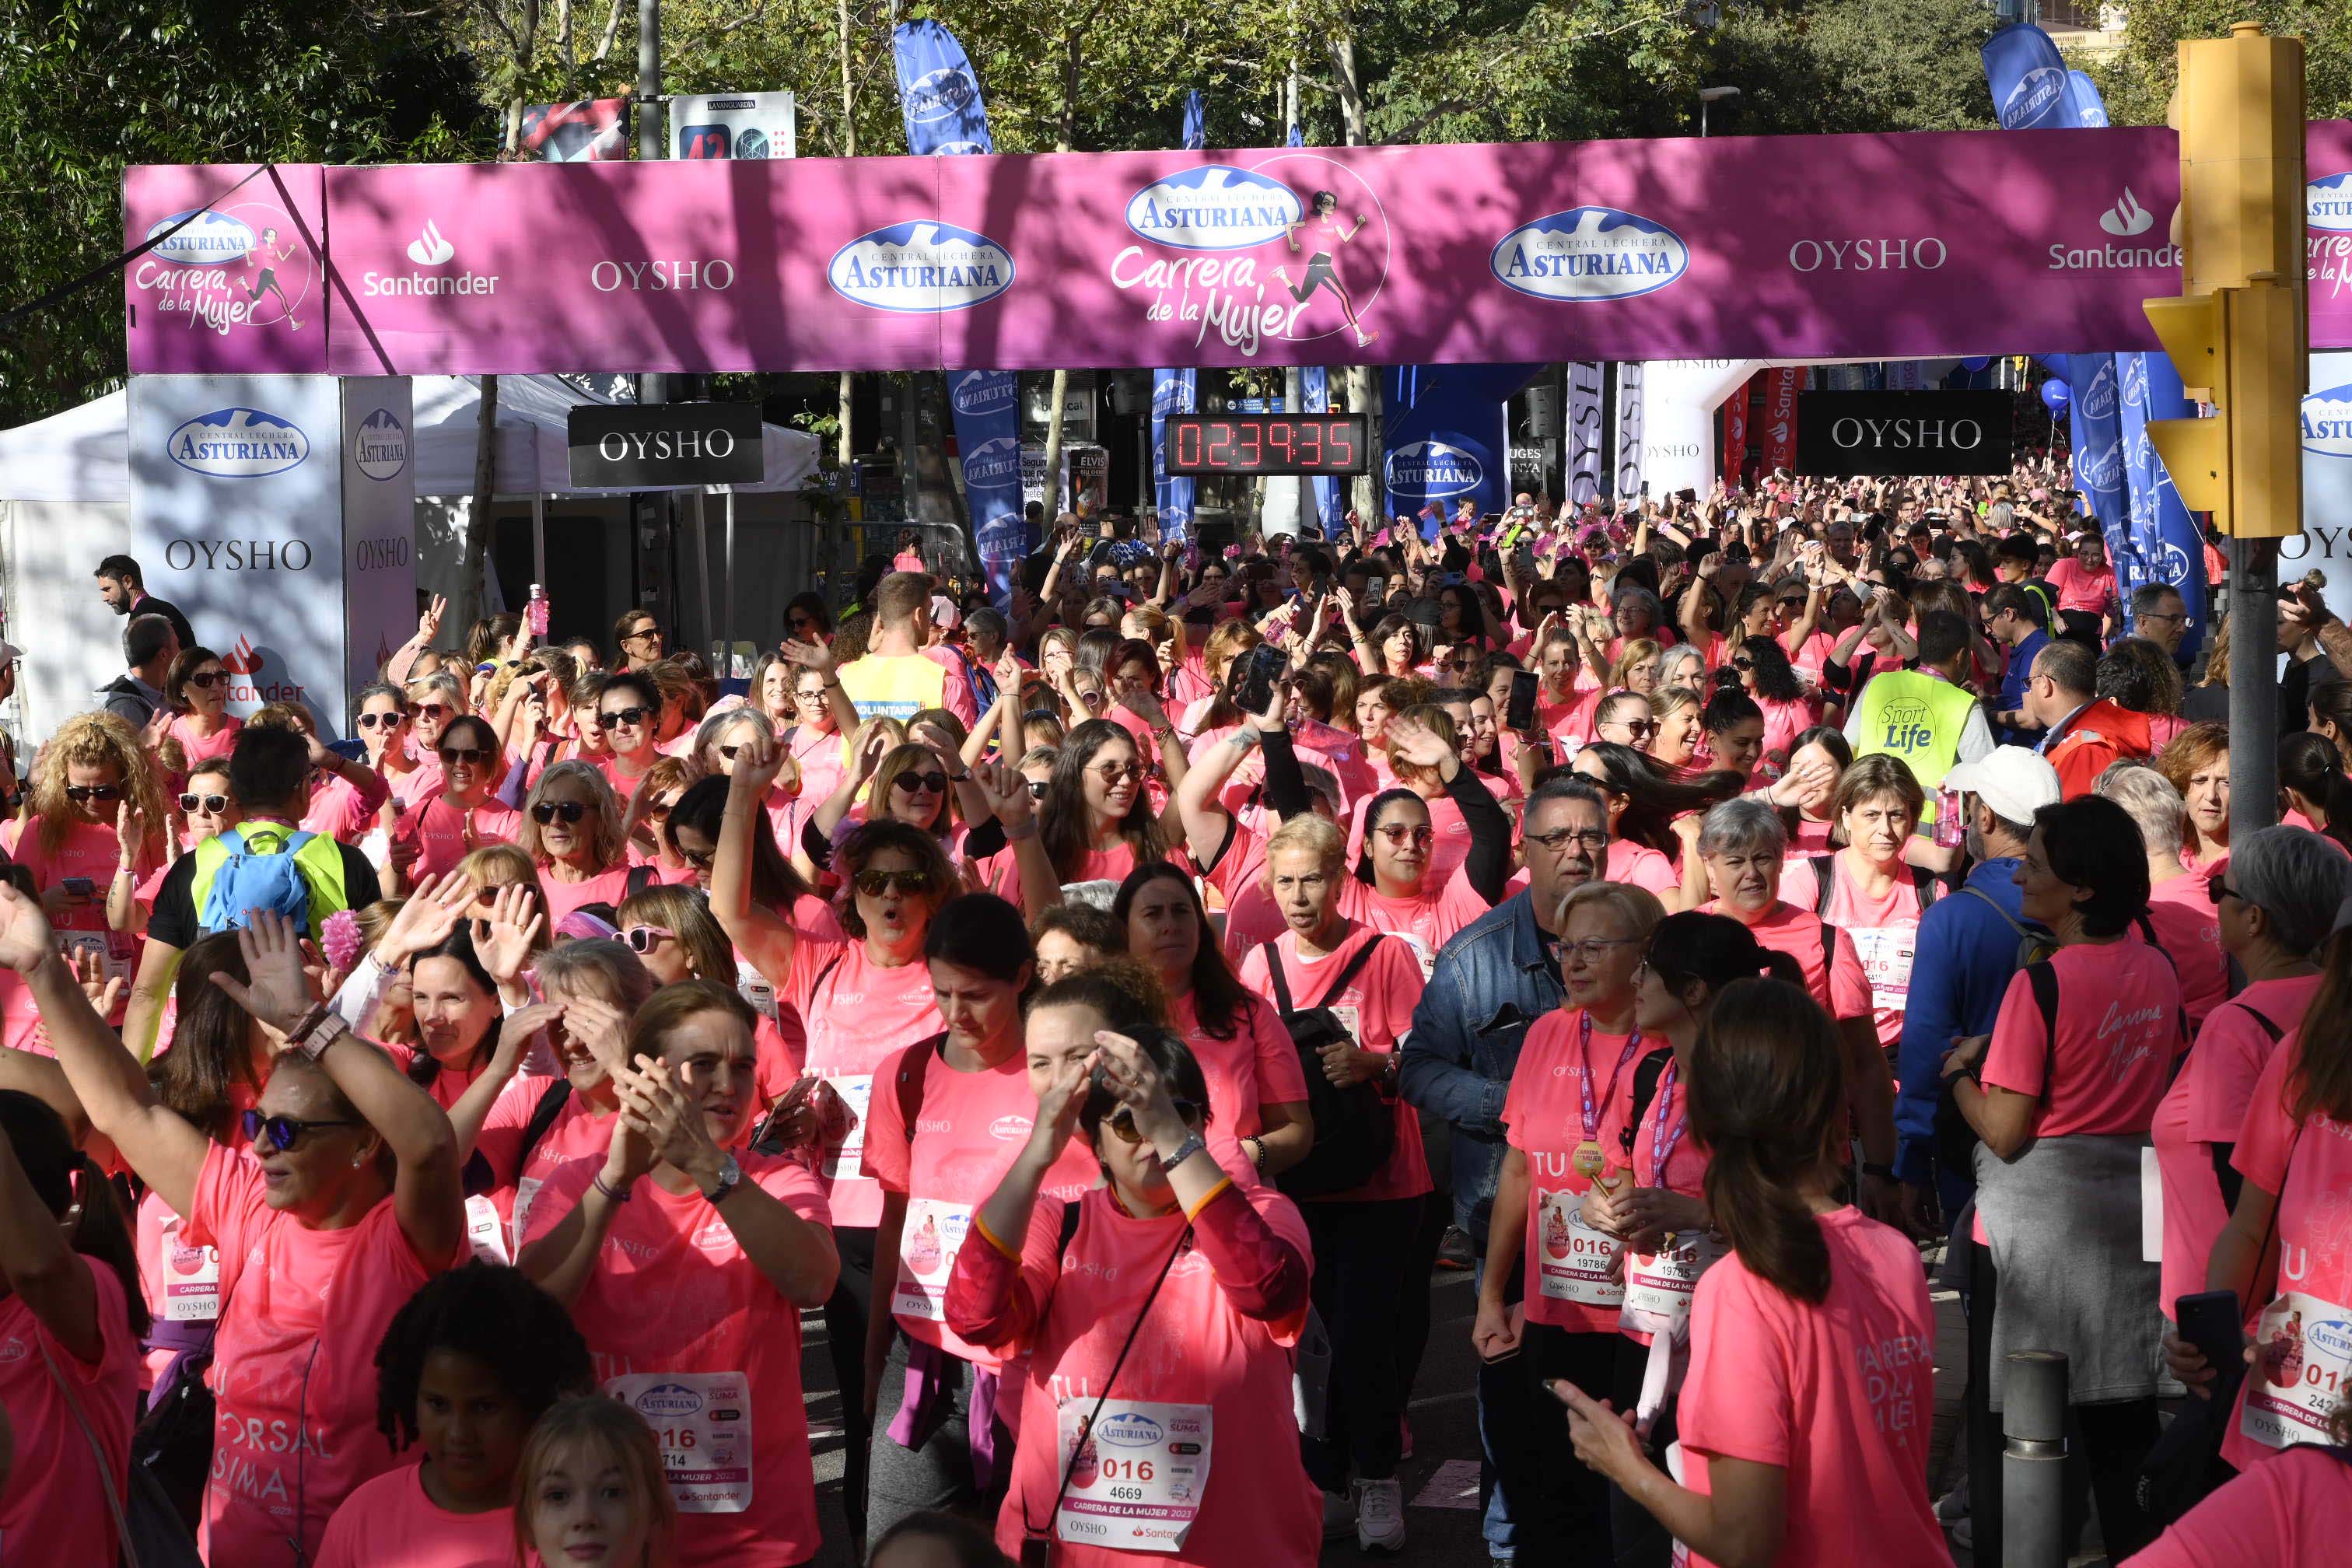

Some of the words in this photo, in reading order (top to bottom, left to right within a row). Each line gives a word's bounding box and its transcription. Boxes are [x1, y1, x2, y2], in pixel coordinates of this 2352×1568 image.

[1139, 196, 1289, 228] ASTURIANA
[1536, 240, 1598, 250] CENTRAL
[1603, 238, 1668, 248] LECHERA
[1789, 236, 1948, 272] OYSHO
[871, 251, 930, 262] CENTRAL
[1111, 245, 1258, 289] Carrera
[1506, 243, 1673, 278] ASTURIANA
[2049, 243, 2184, 270] Santande
[135, 261, 226, 290] Carrera
[590, 259, 734, 292] OYSHO
[843, 255, 1001, 289] ASTURIANA
[363, 270, 499, 296] Santander
[158, 292, 175, 311] de
[179, 291, 191, 312] la
[189, 287, 262, 336] Mujer
[1146, 291, 1172, 322] de
[1178, 290, 1199, 321] la
[1195, 283, 1311, 357] Mujer
[1571, 361, 1601, 510] OYSH
[1619, 361, 1641, 500] OYSH
[1832, 417, 1983, 450] OYSHO
[179, 434, 299, 460] ASTURIANA
[359, 436, 404, 464] ASTURIANA
[599, 429, 734, 461] OYSHO
[1178, 423, 1352, 466] 02:39:35
[1510, 448, 1542, 459] UGES
[1080, 457, 1104, 467] ELVIS
[1511, 464, 1541, 473] NYA
[1388, 468, 1475, 485] ASTURIANA
[164, 539, 313, 571] OYSHO
[356, 536, 408, 571] OYSHO
[227, 681, 305, 702] tander
[856, 705, 917, 716] VOLUNTARIS
[1881, 705, 1927, 726] Sport
[1883, 723, 1932, 754] Life
[1532, 1151, 1566, 1177] TU
[1573, 1237, 1612, 1256] 016
[1551, 1268, 1579, 1278] CARRERA
[1579, 1270, 1589, 1279] DE
[1577, 1258, 1606, 1270] 19786
[1661, 1265, 1691, 1278] 19785
[180, 1285, 215, 1293] CARRERA
[1640, 1276, 1661, 1286] CARRERA
[1661, 1280, 1671, 1289] DE
[177, 1300, 216, 1313] OYSHO
[641, 1397, 698, 1409] ASTURIANA
[709, 1391, 739, 1401] SUMA
[2264, 1400, 2305, 1419] CARRERA
[2305, 1412, 2317, 1425] DE
[654, 1428, 697, 1448] 16
[1101, 1424, 1158, 1440] ASTURIANA
[1169, 1423, 1201, 1433] SUMA
[2255, 1418, 2301, 1444] OYSHO
[663, 1454, 686, 1467] 714
[1103, 1458, 1154, 1481] 016
[681, 1472, 712, 1482] MUJER
[691, 1491, 740, 1501] Santander
[1110, 1486, 1142, 1500] 4669
[1073, 1501, 1108, 1514] CARRERA
[1108, 1506, 1122, 1515] DE
[1122, 1507, 1135, 1516] LA
[1136, 1508, 1168, 1517] MUJER
[1171, 1509, 1192, 1518] 2023
[1070, 1520, 1108, 1535] OYSHO
